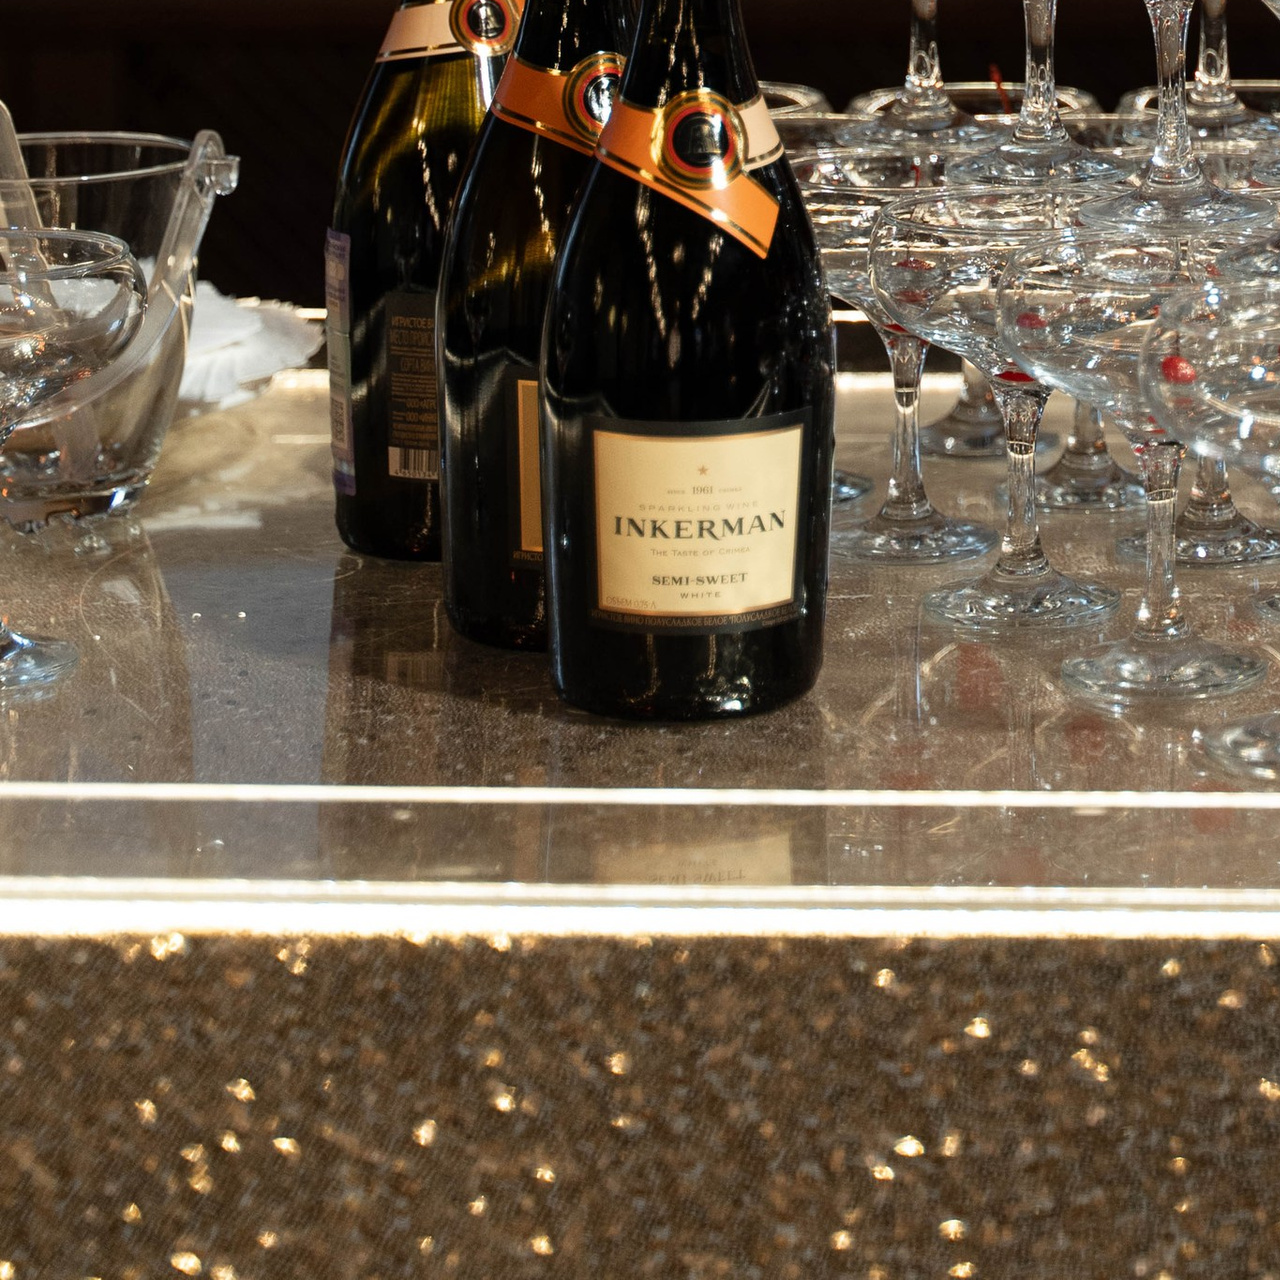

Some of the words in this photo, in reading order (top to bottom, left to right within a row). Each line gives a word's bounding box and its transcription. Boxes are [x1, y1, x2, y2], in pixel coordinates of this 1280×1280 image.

[692, 485, 714, 495] 1961
[639, 503, 721, 513] SPARKLING
[726, 500, 759, 511] WINE
[614, 510, 786, 541] INKERMAN
[651, 572, 749, 586] SEMI-SWEET
[679, 591, 722, 600] WHITE
